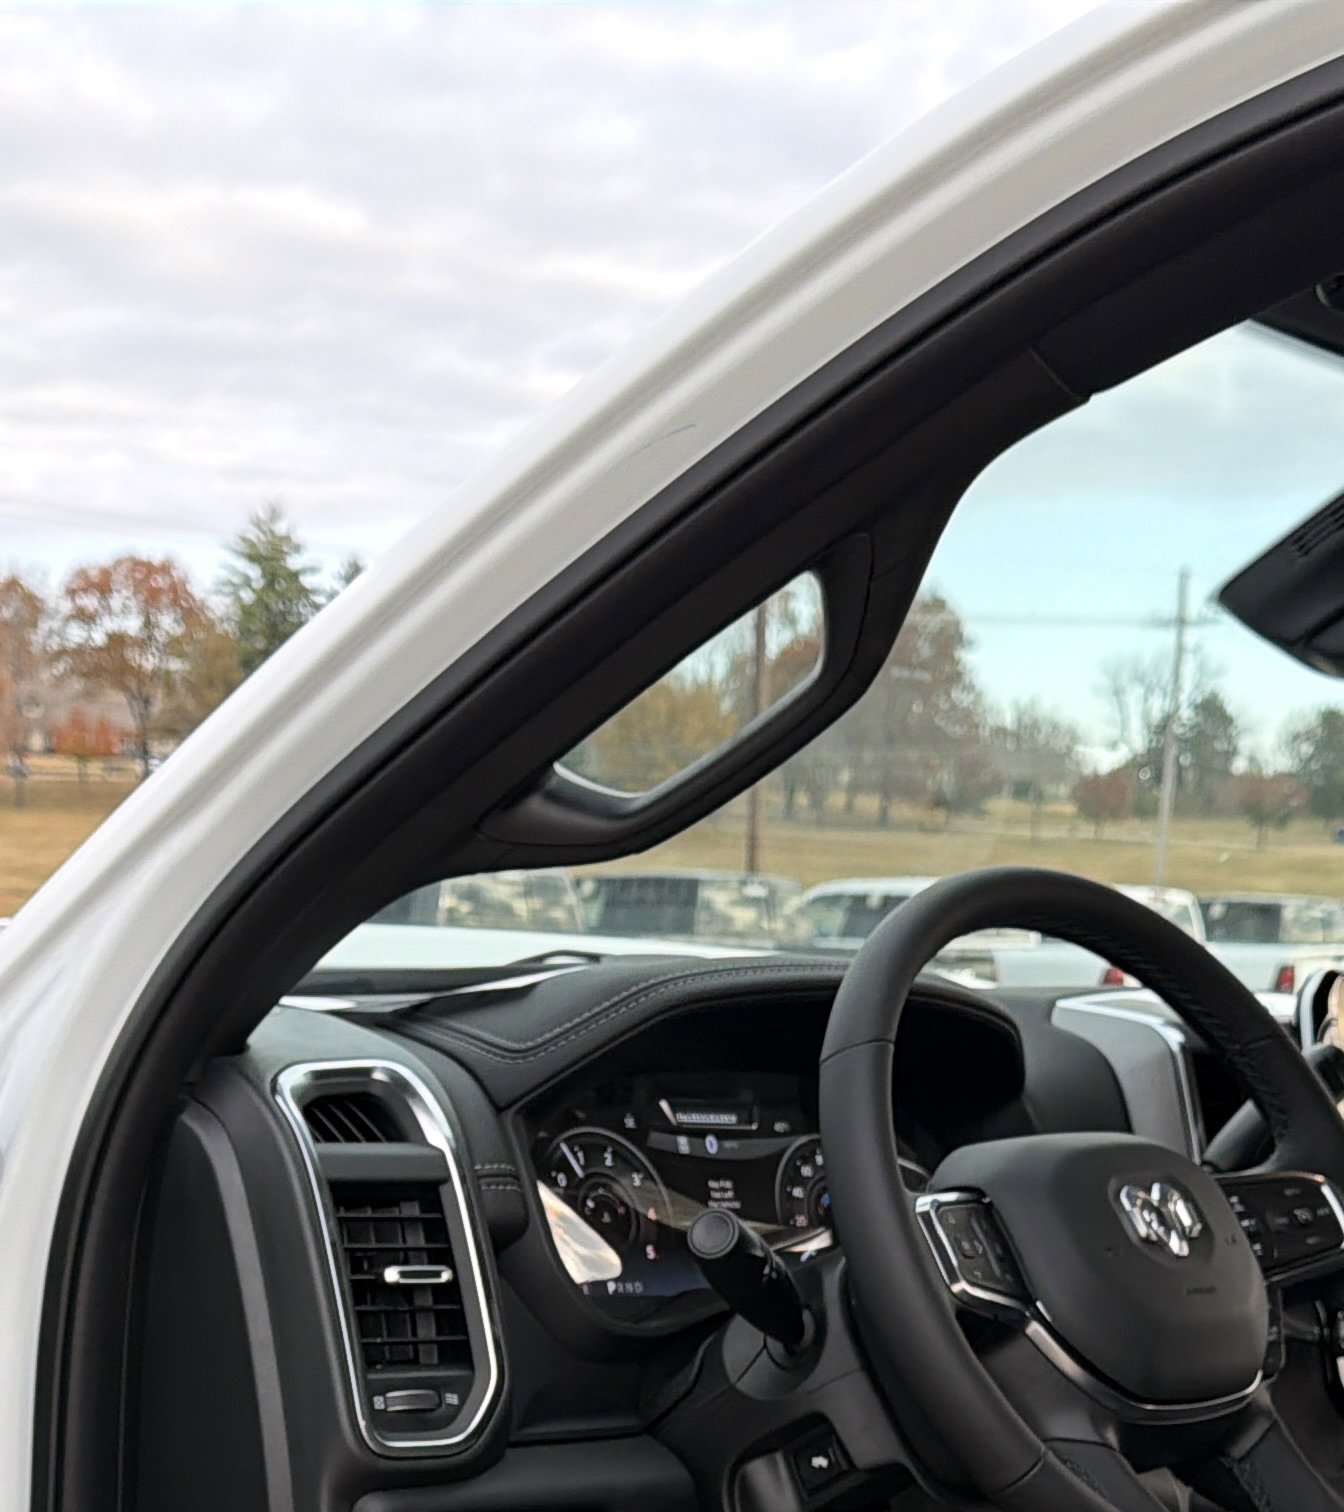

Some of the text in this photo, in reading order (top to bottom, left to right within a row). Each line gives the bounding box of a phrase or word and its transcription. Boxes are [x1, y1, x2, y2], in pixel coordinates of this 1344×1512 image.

[577, 1150, 585, 1166] 1
[603, 1151, 614, 1167] 2
[557, 1171, 568, 1188] 0
[631, 1171, 642, 1187] 3
[645, 1244, 657, 1261] 5
